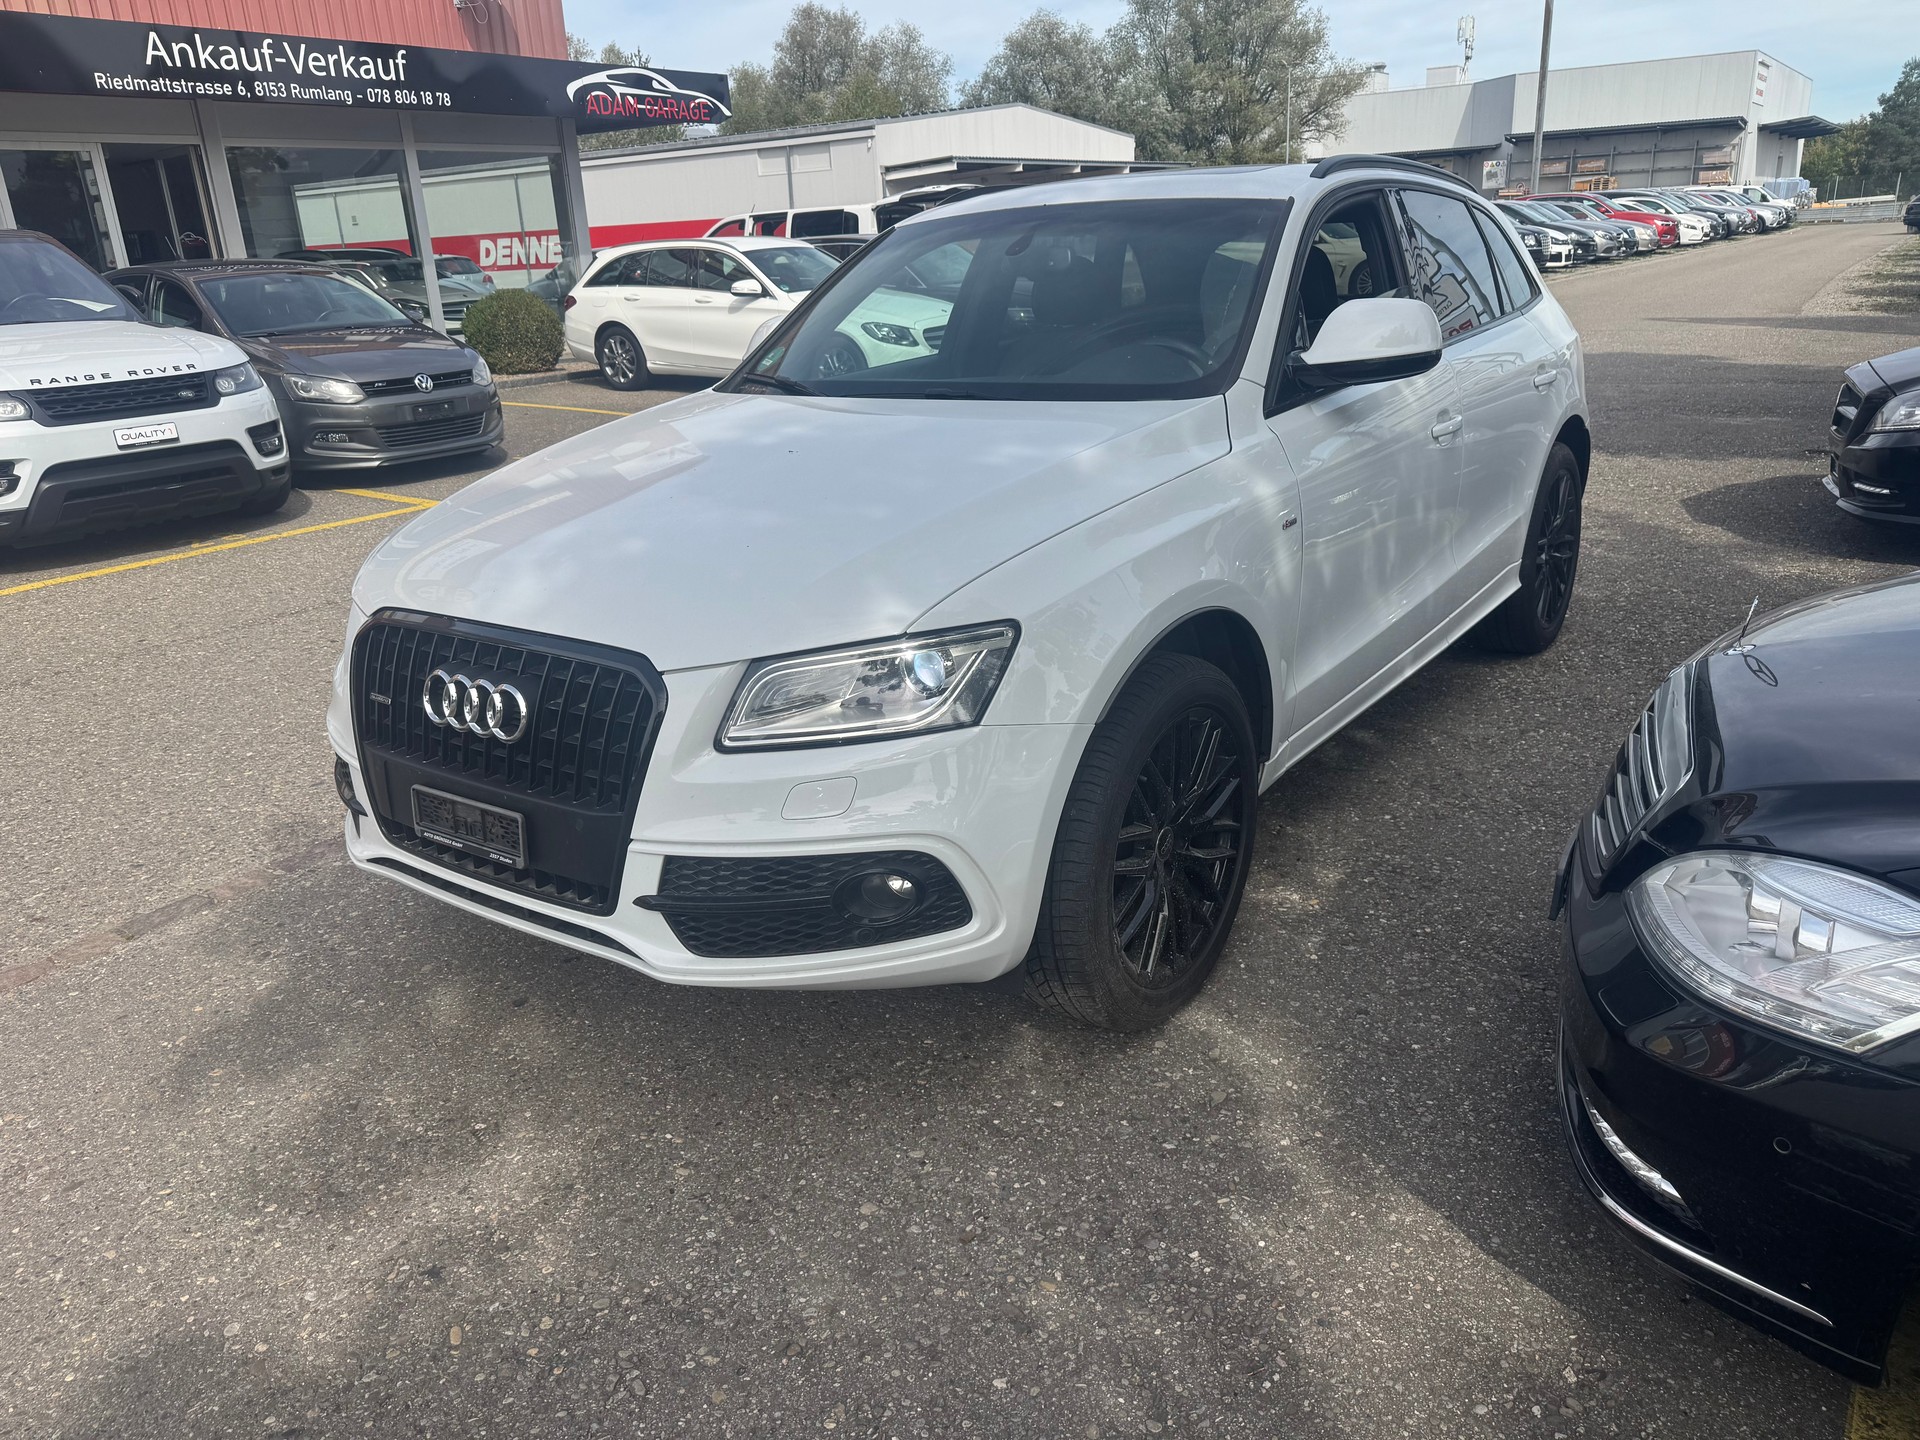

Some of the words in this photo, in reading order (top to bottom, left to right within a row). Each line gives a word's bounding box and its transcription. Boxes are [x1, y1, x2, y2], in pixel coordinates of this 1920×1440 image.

[145, 31, 407, 81] Ankauf-Verkauf
[94, 72, 233, 95] Riedmattstrasse
[237, 80, 251, 98] 6,
[255, 81, 287, 97] 8153
[290, 83, 353, 104] Rumlang
[366, 88, 391, 104] 078
[394, 89, 417, 104] 806
[420, 90, 433, 105] 18
[436, 91, 451, 106] 78
[587, 94, 639, 117] ADAM
[645, 98, 710, 121] GARAGE
[30, 372, 112, 386] RANGE
[127, 363, 197, 377] ROVER
[121, 428, 166, 441] QUALITY
